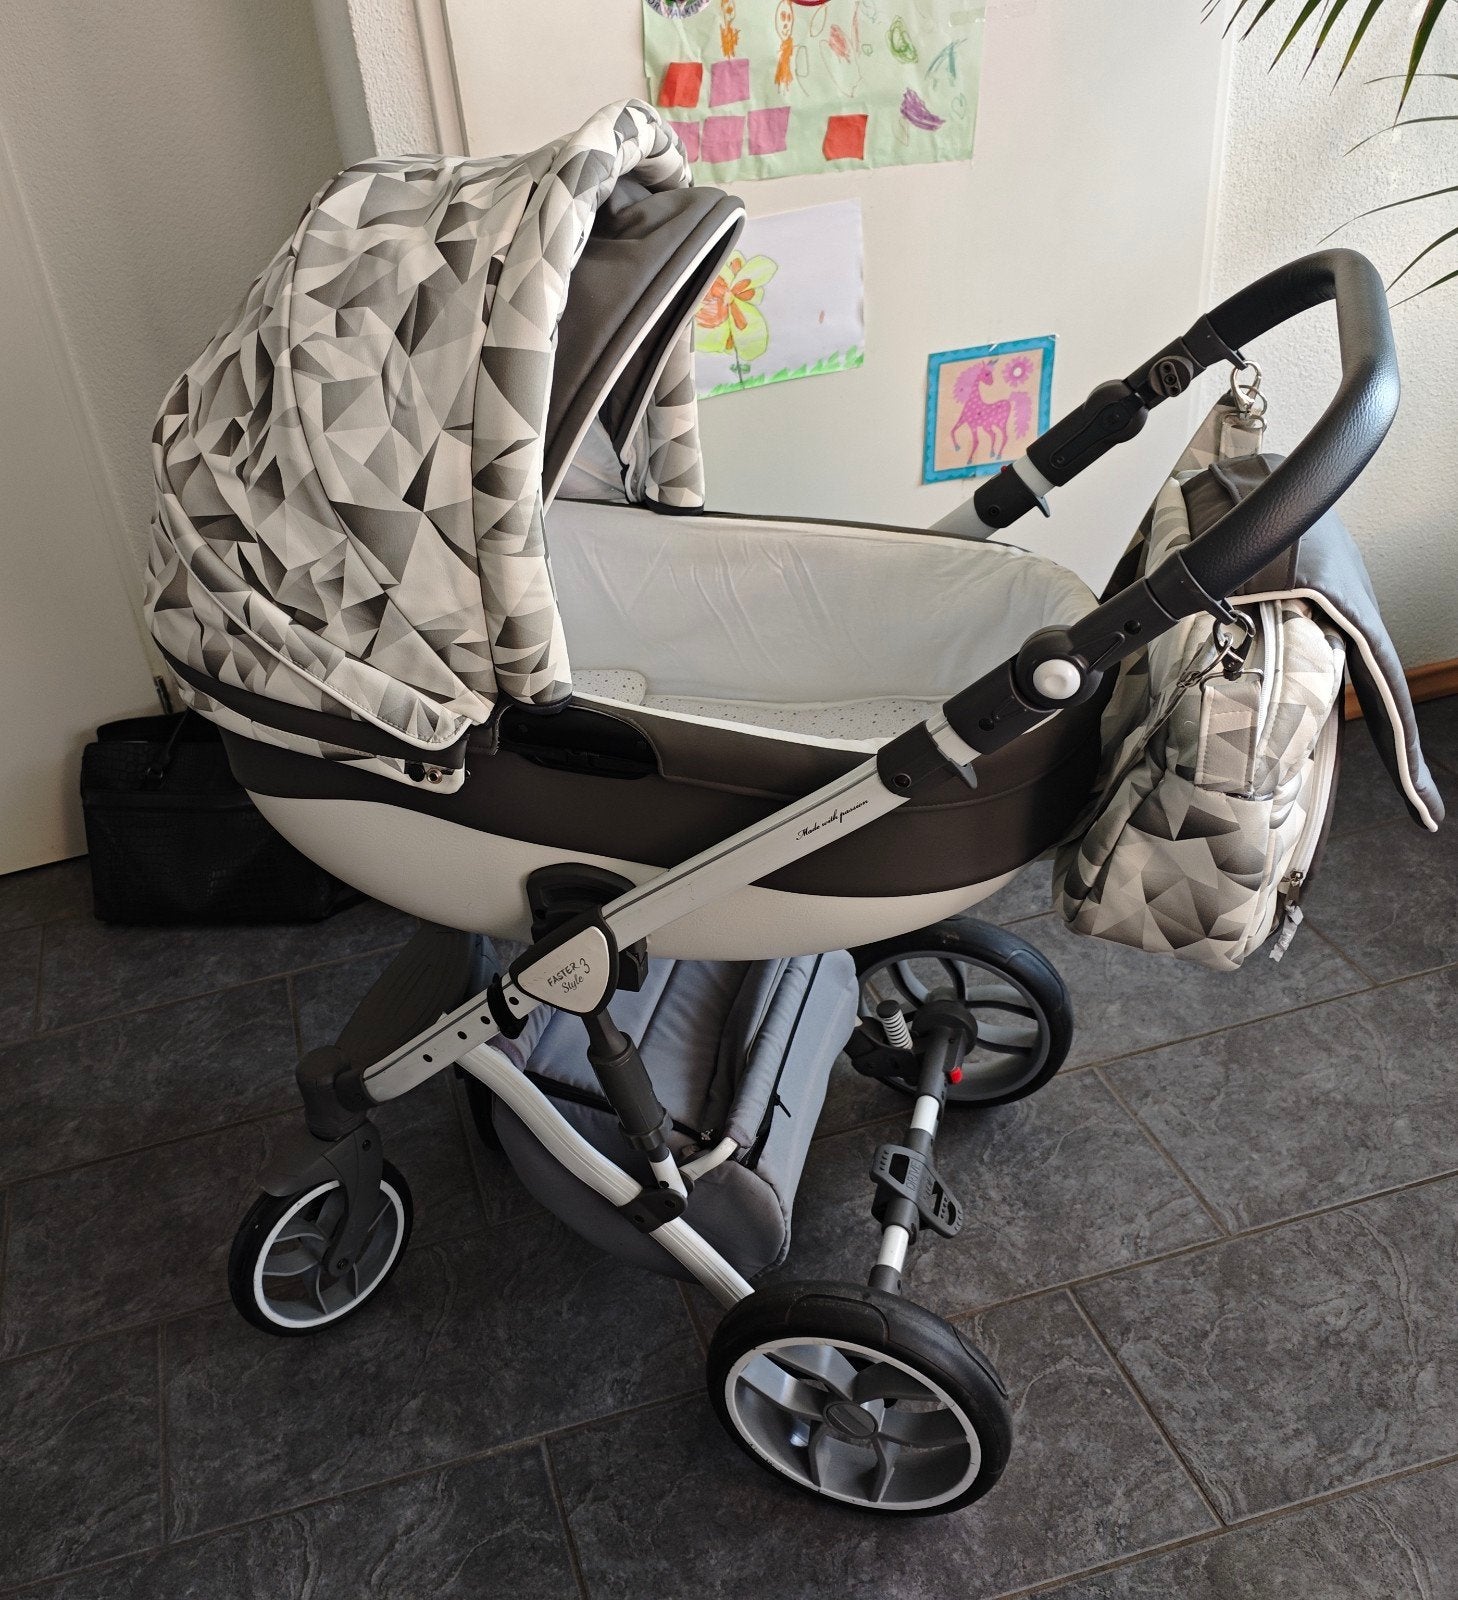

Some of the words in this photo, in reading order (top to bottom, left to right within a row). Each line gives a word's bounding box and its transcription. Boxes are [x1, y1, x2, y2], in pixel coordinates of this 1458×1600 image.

[796, 822, 820, 841] Made
[822, 809, 838, 827] with
[840, 799, 869, 823] passion
[547, 962, 580, 987] FASTER
[580, 957, 591, 974] 3
[562, 974, 584, 994] Style
